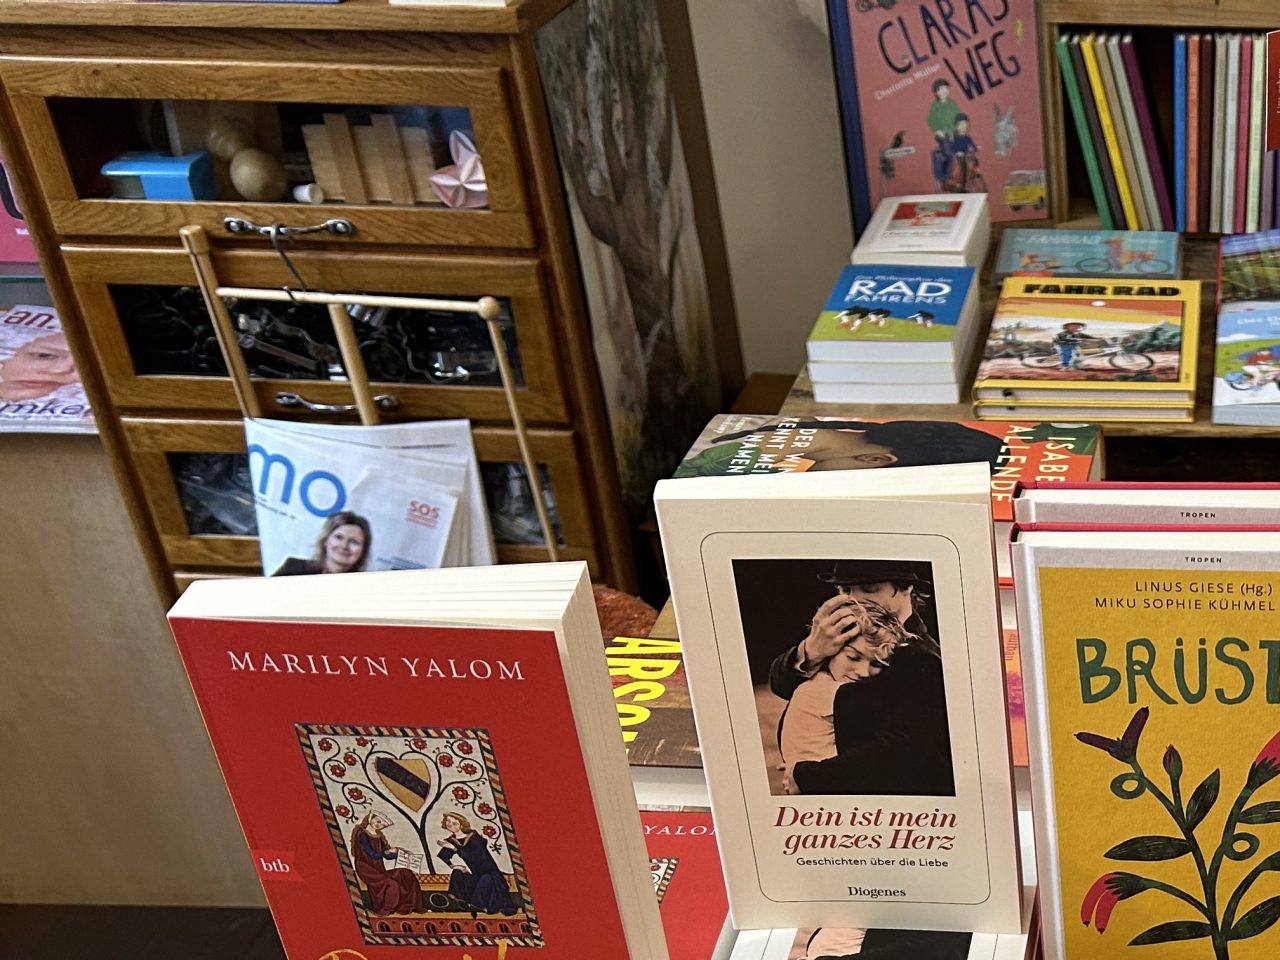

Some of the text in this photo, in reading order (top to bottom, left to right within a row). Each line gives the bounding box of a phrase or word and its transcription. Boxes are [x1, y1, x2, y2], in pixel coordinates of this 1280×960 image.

[943, 31, 1021, 100] WEG
[848, 280, 952, 297] RAD
[1023, 283, 1181, 297] FAHR RAD
[844, 294, 947, 304] FAHRENS
[765, 417, 801, 450] KENNT
[790, 428, 818, 449] DER
[725, 434, 765, 474] NAMEN
[990, 425, 1037, 503] ALLENDE
[408, 500, 441, 520] SOS
[1180, 511, 1217, 519] TROPEN
[1184, 556, 1223, 564] TROPEN
[1135, 581, 1273, 597] LINUS GIESE (Hg.)
[1095, 597, 1137, 610] MIKU
[1143, 598, 1202, 611] SOPHIE
[1208, 597, 1276, 612] KÜHMEL
[226, 650, 525, 681] MARILYN YALOM
[773, 806, 957, 828] Dein ist mein
[782, 829, 956, 855] ganzes Herz
[260, 856, 290, 875] btb
[796, 857, 949, 868] Geschichten über die Liebe
[848, 885, 907, 899] Diogenes
